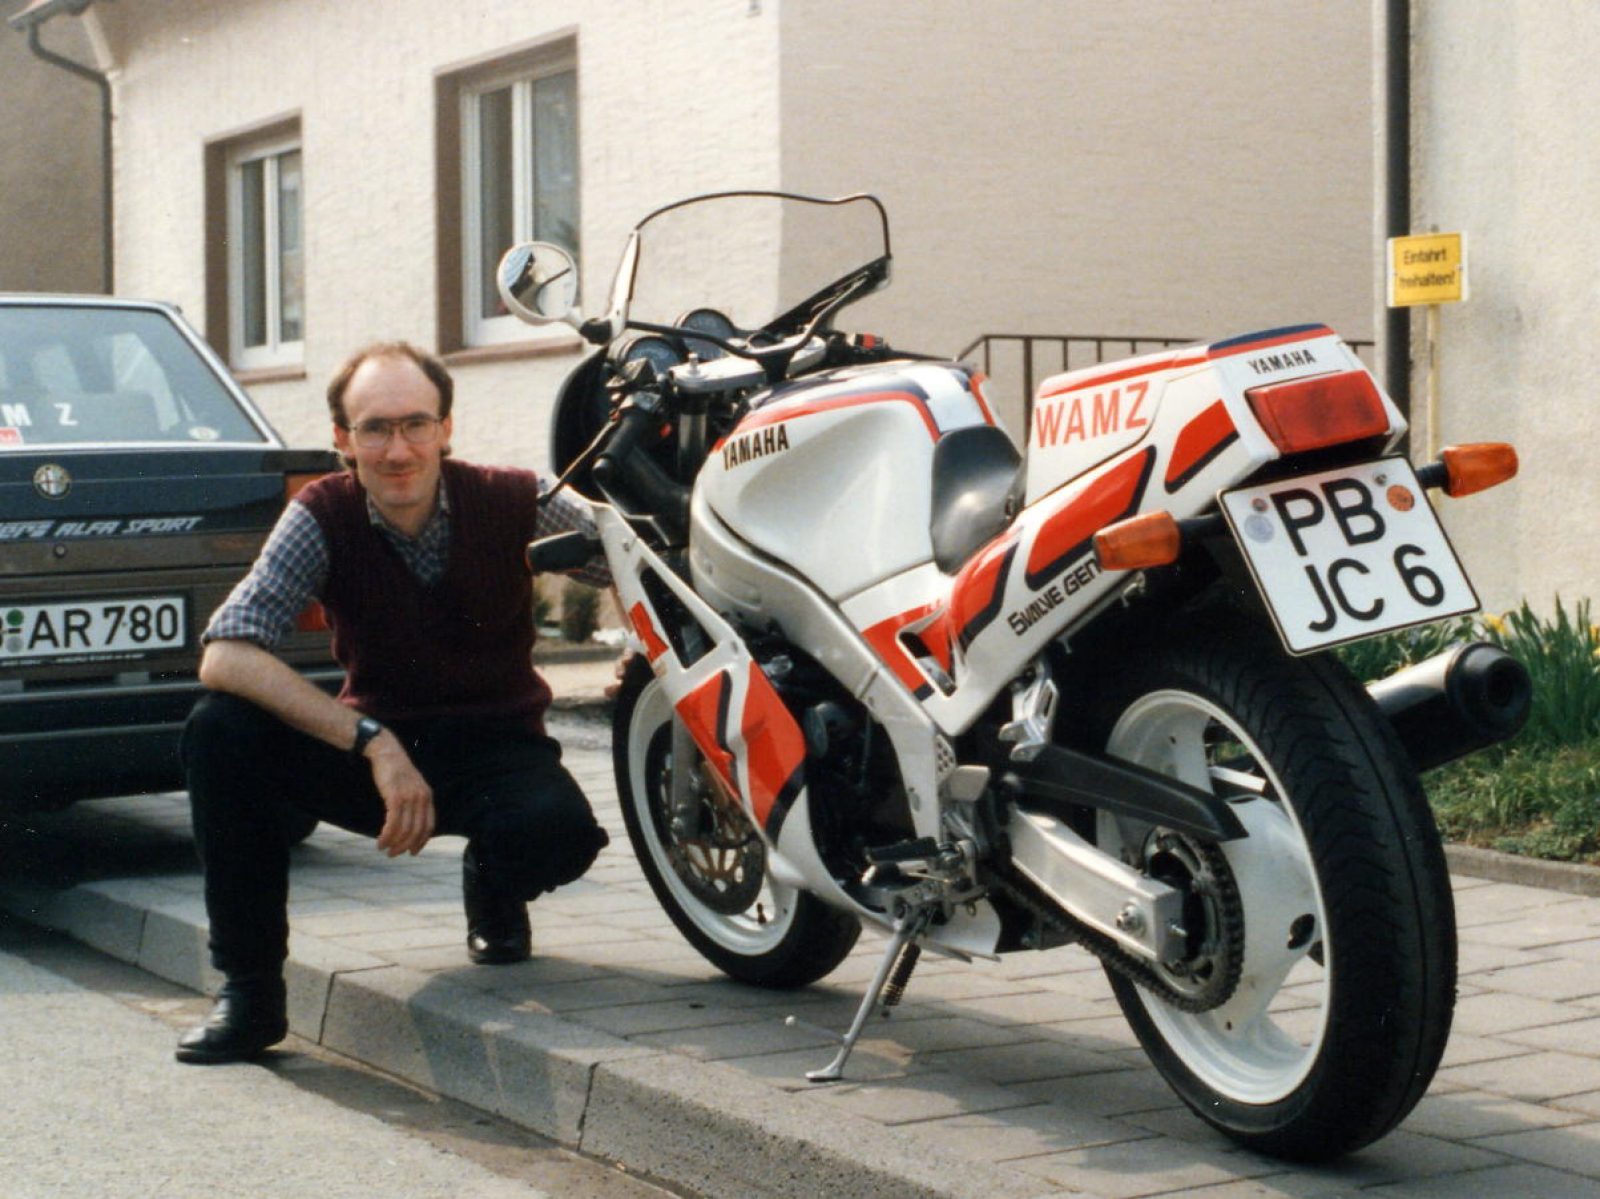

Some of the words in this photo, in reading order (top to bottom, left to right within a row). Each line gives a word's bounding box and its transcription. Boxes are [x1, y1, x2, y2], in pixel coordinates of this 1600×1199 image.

[1248, 348, 1317, 375] YAMAHA
[1036, 380, 1150, 449] WAMZ
[722, 423, 790, 471] YAMAHA
[53, 519, 121, 538] ALFA
[123, 516, 203, 532] SPORT
[1270, 478, 1387, 557] PB
[1307, 557, 1385, 633] JC
[1393, 543, 1446, 607] 6
[103, 603, 179, 646] 780
